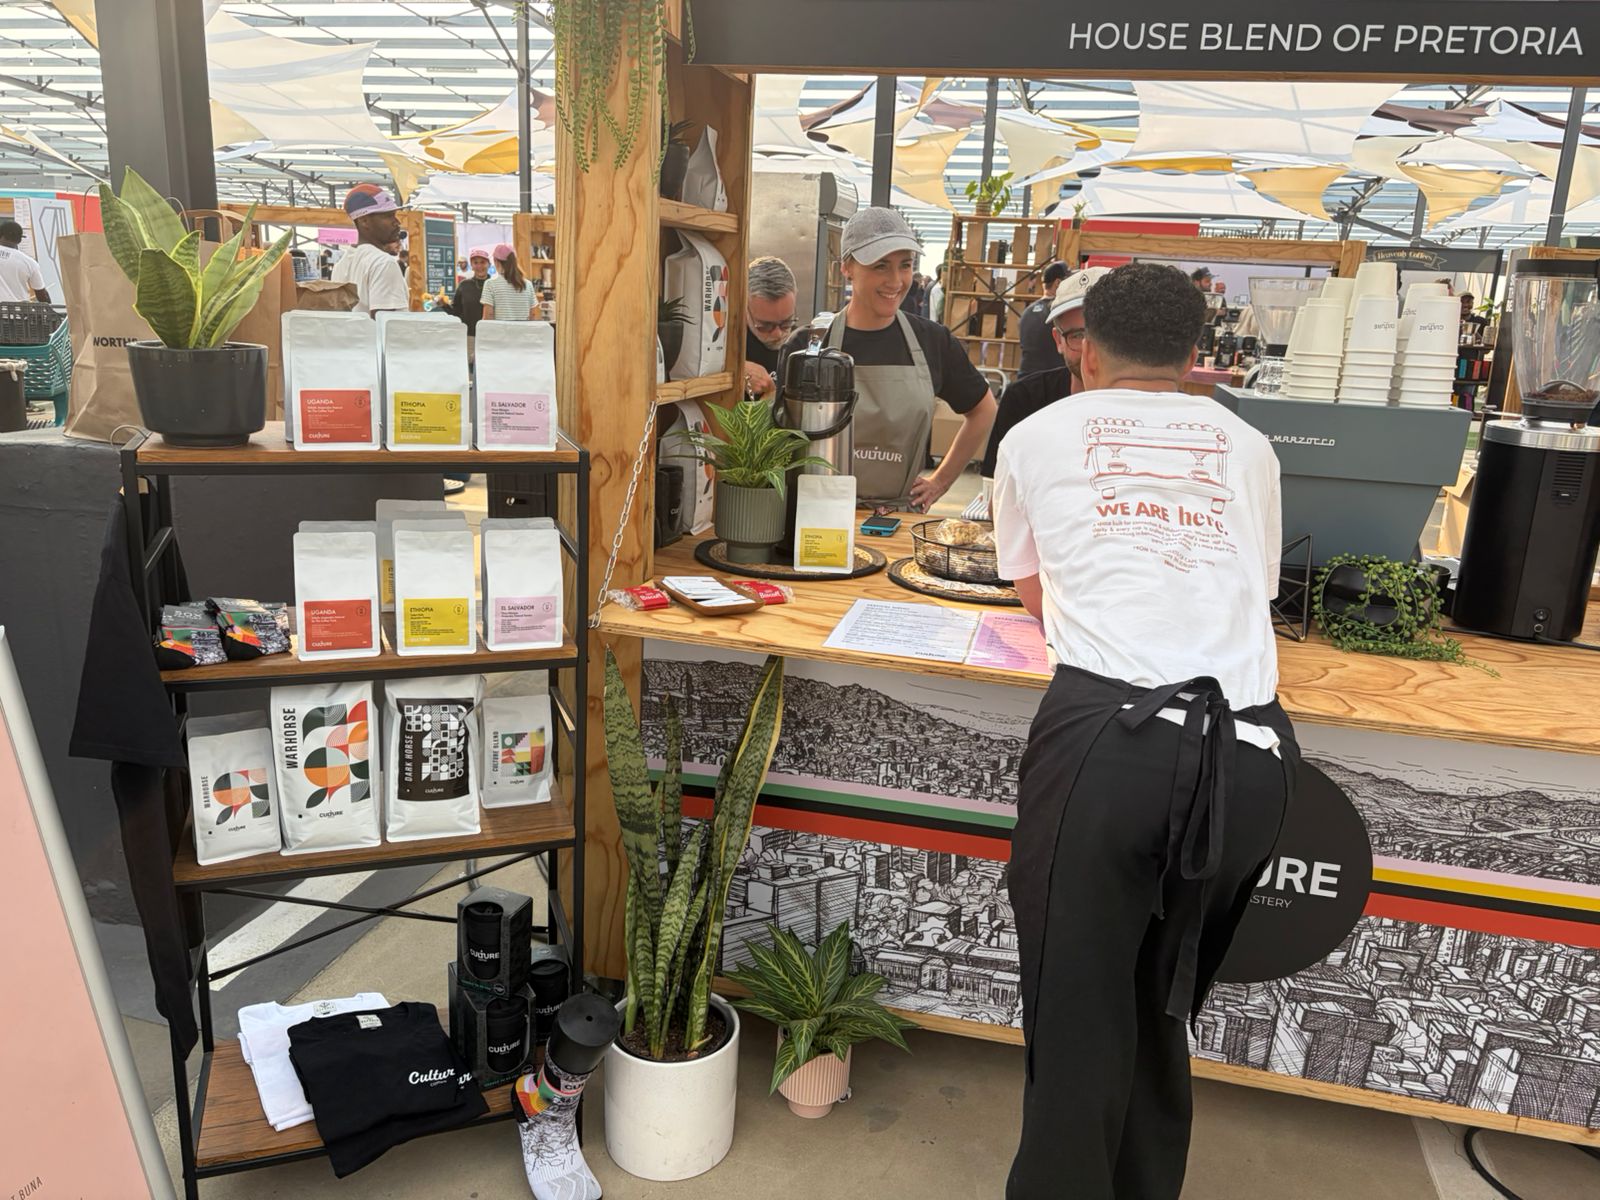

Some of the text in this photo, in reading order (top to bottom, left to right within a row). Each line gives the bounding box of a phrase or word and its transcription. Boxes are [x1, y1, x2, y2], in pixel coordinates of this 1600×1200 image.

[1069, 22, 1584, 55] HOUSE BLEND OF PRETORIA
[1377, 249, 1433, 261] Heavenly Coffees
[1273, 434, 1336, 447] MARZOCCO
[853, 446, 903, 462] KULTUUR
[1096, 502, 1131, 517] WE
[1135, 501, 1170, 523] ARE
[1178, 505, 1229, 536] here.
[640, 592, 664, 601] Biscoff
[311, 608, 336, 616] UGANDA
[283, 707, 299, 770] WARHORSE
[404, 735, 413, 782] DARK HORSE
[201, 775, 211, 808] WARHORSE
[319, 810, 343, 818] CULTURE
[470, 949, 500, 960] CULTURE
[488, 1040, 521, 1053] CULTURE
[408, 1068, 456, 1085] Cultur
[18, 1176, 43, 1200] BUNA
